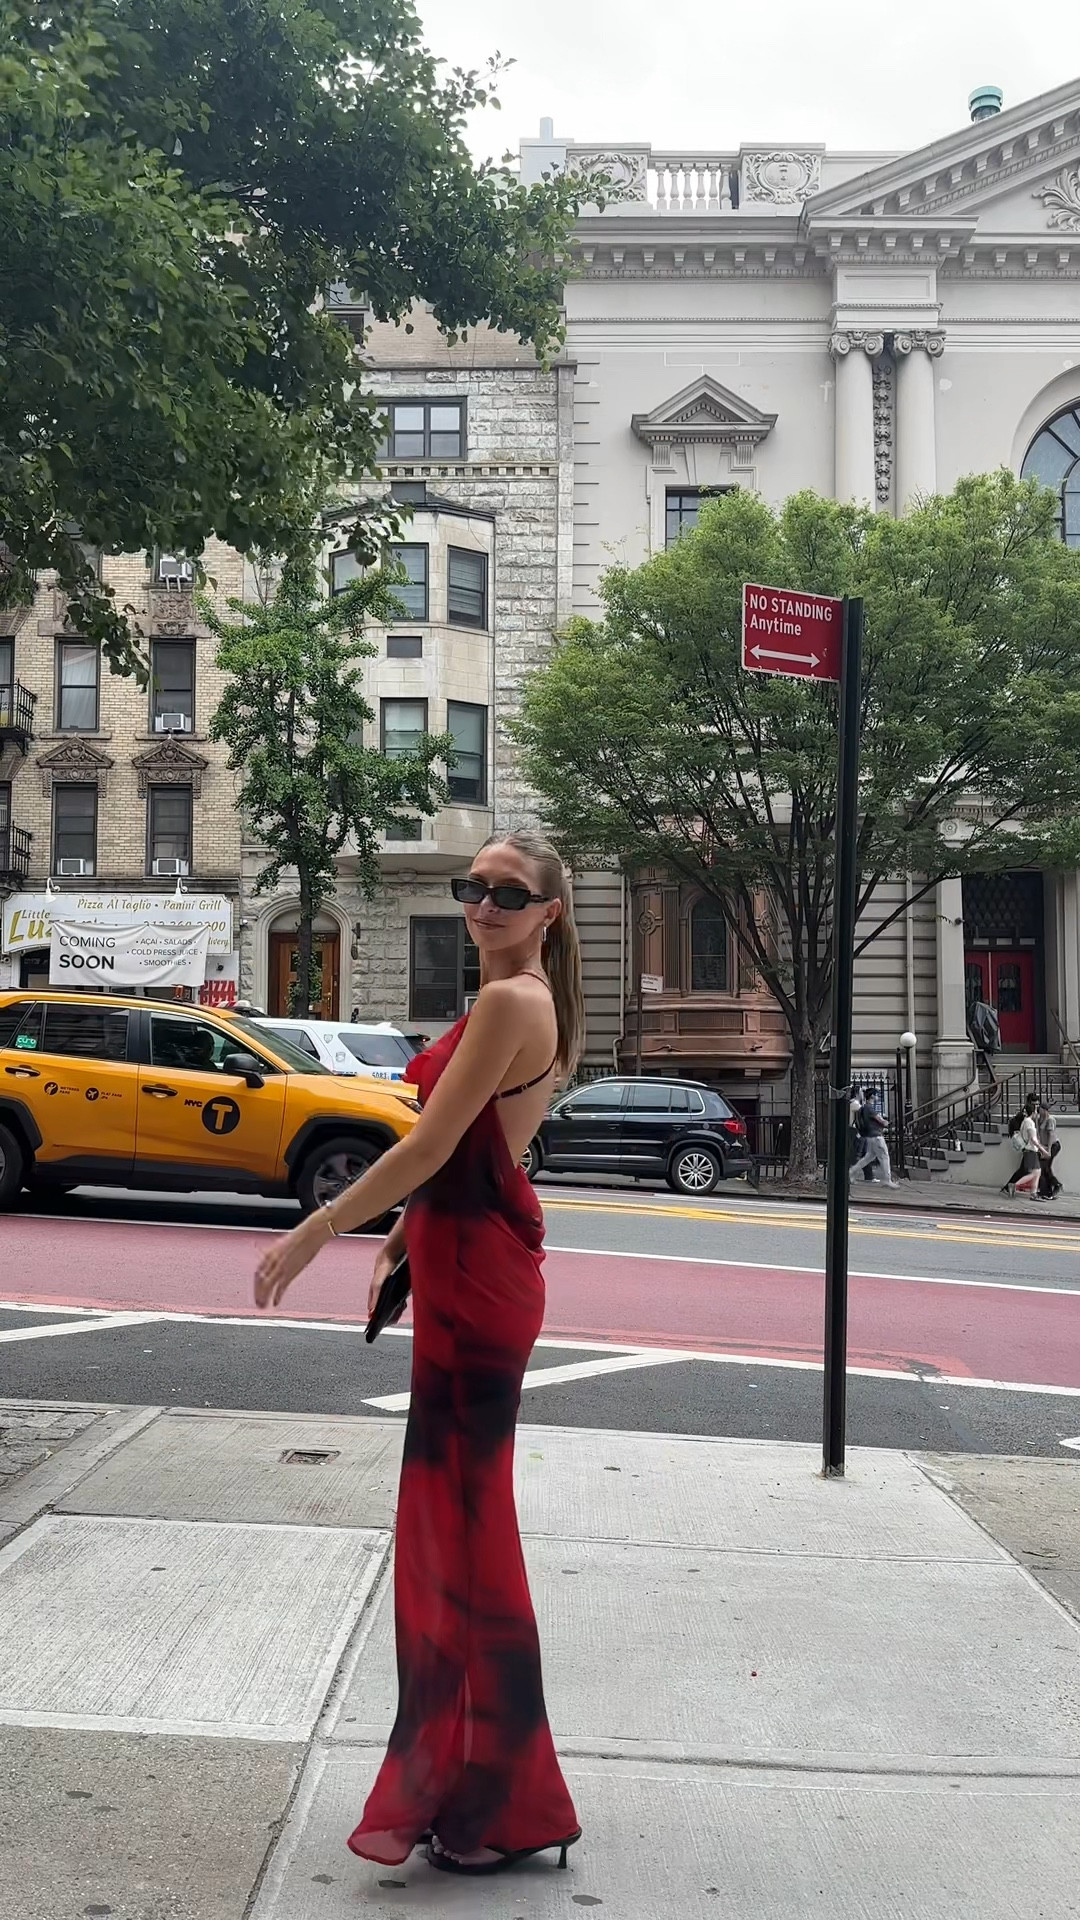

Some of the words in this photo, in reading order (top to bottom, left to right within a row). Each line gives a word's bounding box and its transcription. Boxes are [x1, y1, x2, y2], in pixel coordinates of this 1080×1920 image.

[750, 593, 767, 611] NO
[771, 597, 832, 622] STANDING
[750, 614, 801, 636] Anytime
[77, 899, 103, 909] Pizza
[107, 899, 118, 910] Al
[121, 899, 151, 912] Taglio
[163, 900, 195, 910] Panini
[198, 900, 221, 911] Grill
[21, 909, 50, 919] Little
[59, 935, 116, 948] COMING
[164, 938, 193, 946] SALADS
[131, 948, 152, 956] COLD
[153, 948, 177, 956] PRESS
[59, 954, 115, 970] SOON
[184, 1099, 203, 1108] NYC
[211, 1103, 233, 1131] T
